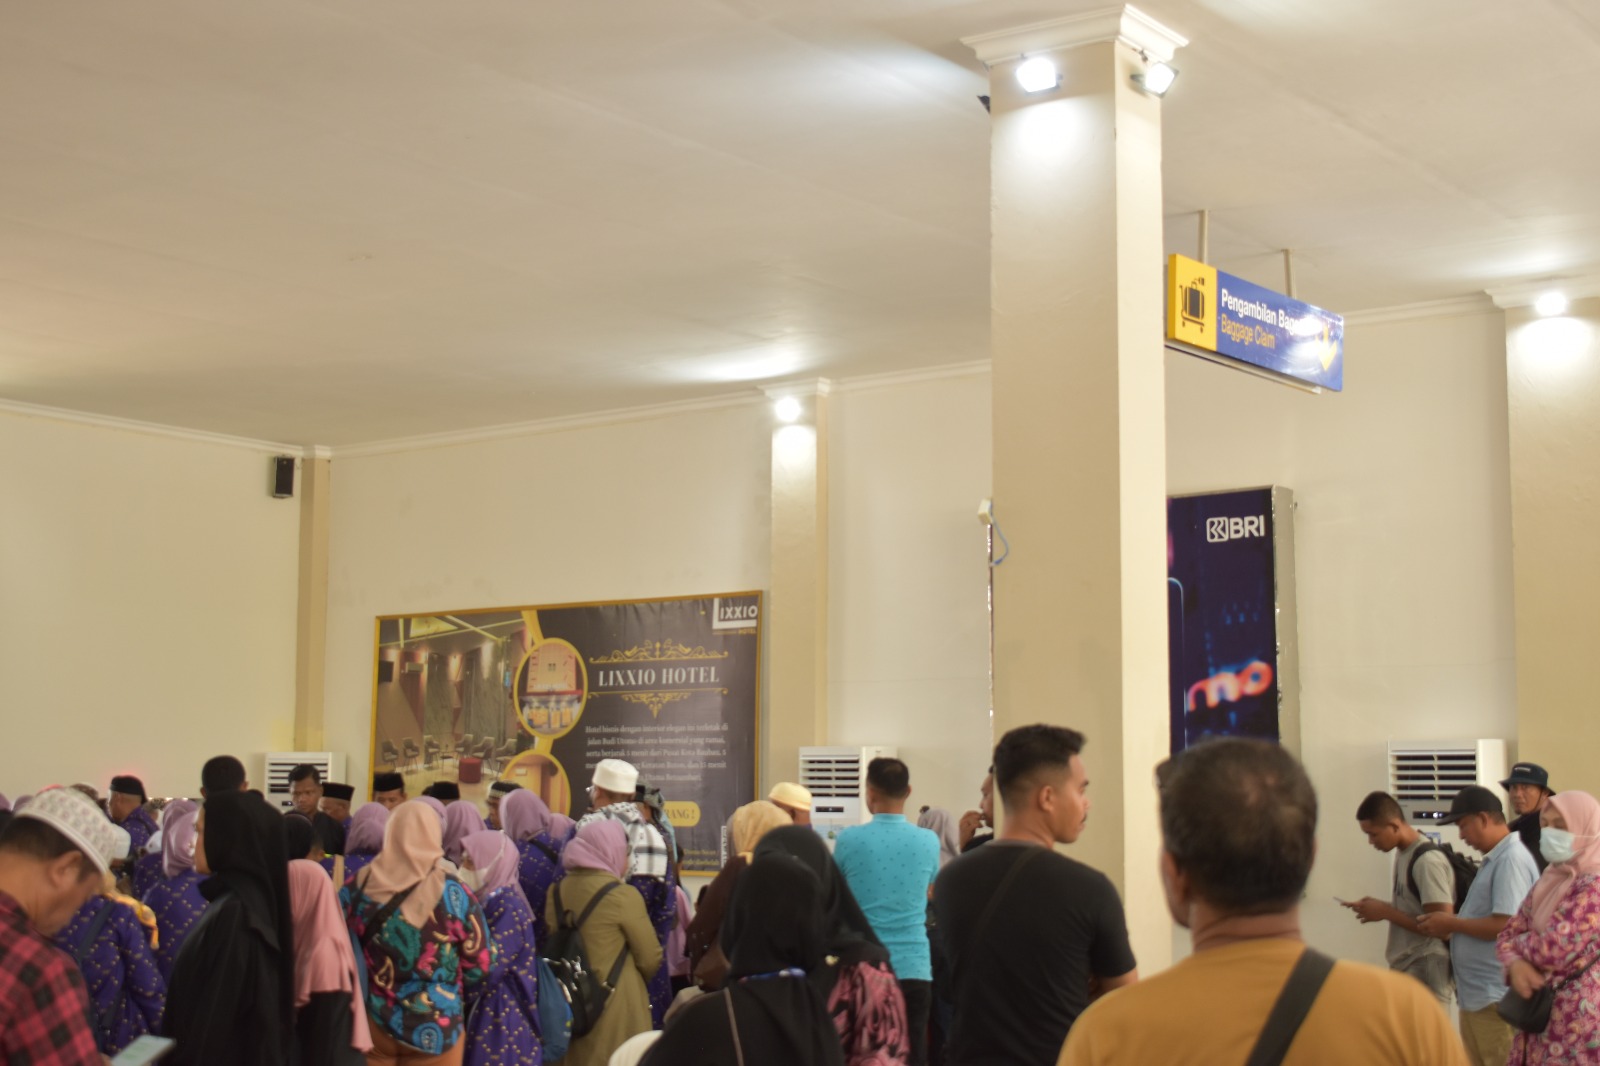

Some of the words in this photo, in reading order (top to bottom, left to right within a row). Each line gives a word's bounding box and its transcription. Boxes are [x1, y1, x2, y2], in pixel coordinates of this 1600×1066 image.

[1221, 288, 1277, 326] Pengambilan
[1221, 313, 1253, 345] Baggage
[1254, 326, 1276, 349] Claim
[1229, 515, 1265, 539] BRI
[599, 669, 656, 687] LIXXIO
[661, 666, 720, 685] HOTEL
[585, 725, 601, 733] Hotel
[620, 725, 642, 734] dengan
[643, 724, 666, 732] interior
[667, 724, 686, 733] elegan
[721, 722, 728, 731] di
[602, 737, 616, 745] Budi
[659, 736, 688, 744] komersial
[689, 737, 704, 746] yang
[601, 749, 626, 758] berjarak
[631, 749, 649, 757] menit
[649, 748, 662, 756] dari
[707, 760, 727, 768] menit
